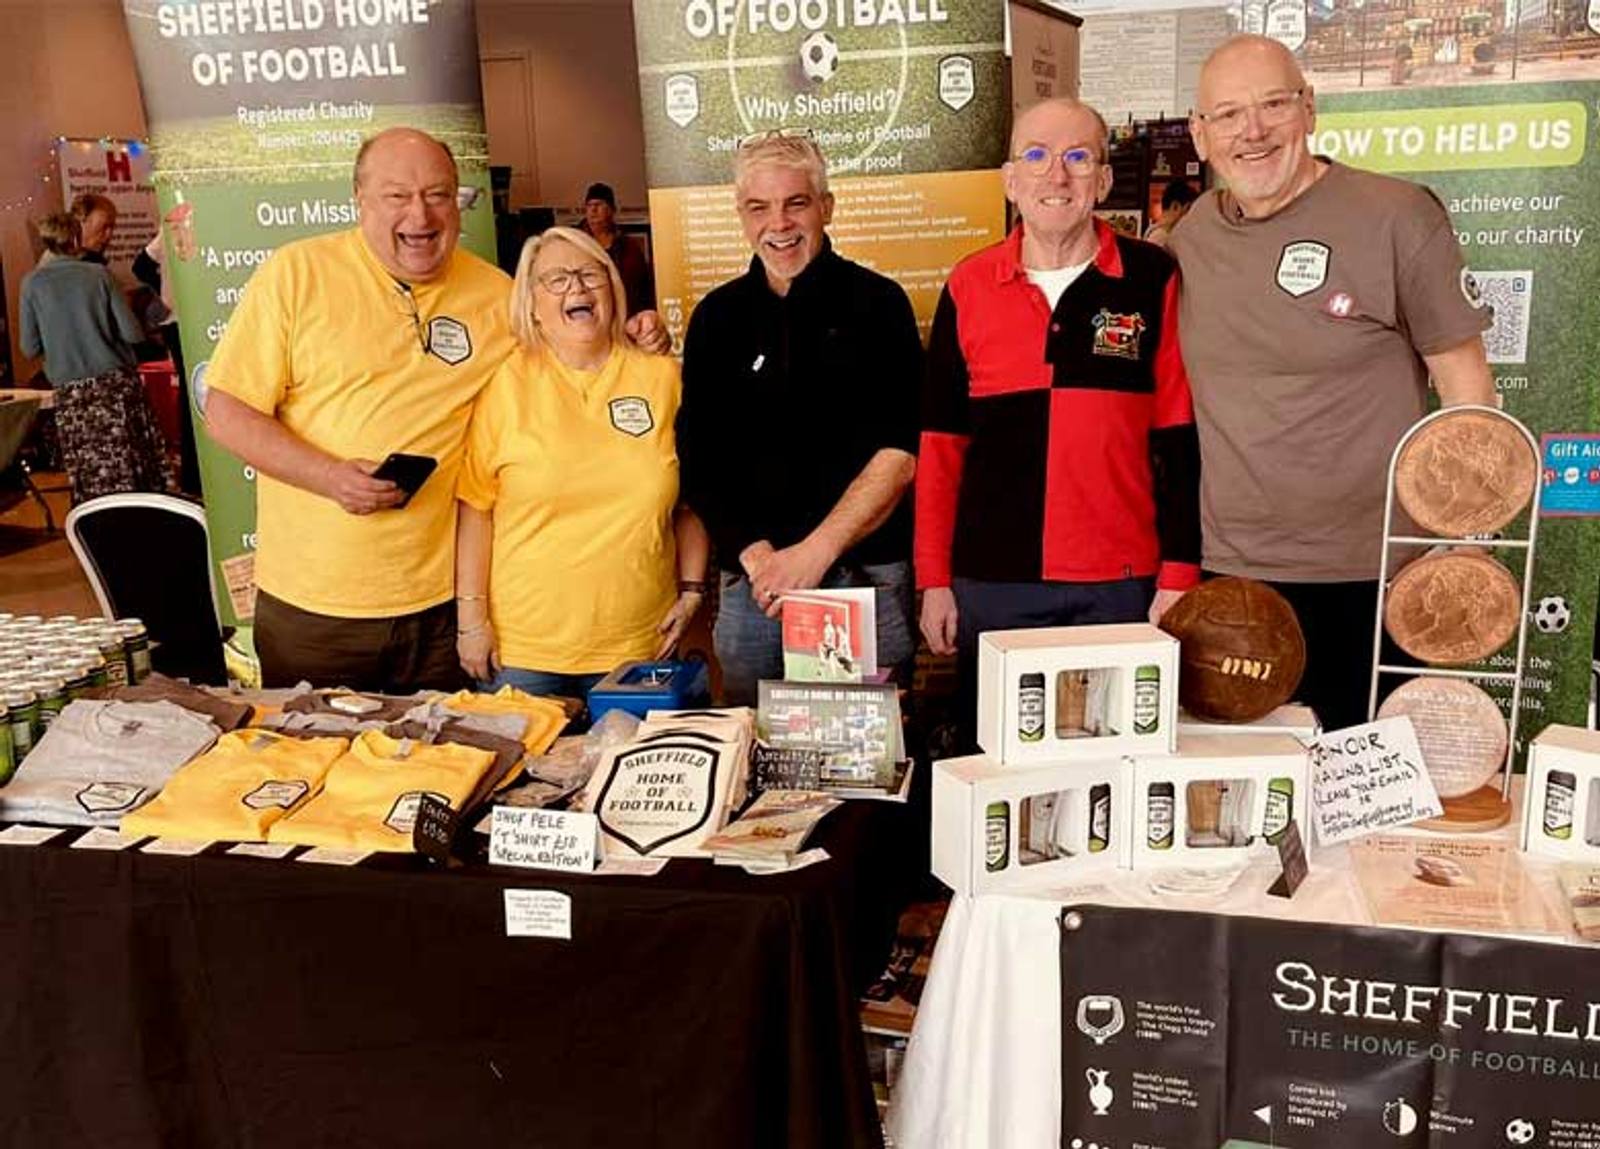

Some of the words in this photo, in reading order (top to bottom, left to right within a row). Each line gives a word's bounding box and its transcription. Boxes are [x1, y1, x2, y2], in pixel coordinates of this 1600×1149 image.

[157, 0, 325, 38] SHEFFIELD
[336, 0, 430, 28] HOME
[685, 0, 736, 38] OF
[750, 0, 949, 34] FOOTBALL
[192, 53, 233, 86] OF
[242, 42, 406, 84] FOOTBALL
[237, 104, 315, 128] Registered
[320, 100, 374, 122] Charity
[746, 96, 789, 125] Why
[795, 88, 901, 118] Sheffield?
[813, 130, 853, 145] Home
[855, 127, 871, 142] of
[1382, 127, 1424, 156] TO
[1435, 122, 1517, 154] HELP
[1528, 119, 1573, 150] US
[838, 154, 861, 169] the
[866, 152, 903, 172] proof
[256, 202, 297, 226] Our
[302, 198, 361, 225] Missi
[1450, 193, 1524, 213] achieve
[1529, 195, 1563, 211] our
[1477, 230, 1509, 246] our
[1515, 224, 1585, 248] charity
[1551, 442, 1578, 457] Gift
[1530, 656, 1553, 670] the
[1345, 732, 1386, 755] OUR
[625, 752, 708, 769] SHEFFIELD
[636, 772, 687, 785] HOME
[646, 786, 670, 798] OF
[609, 799, 697, 813] FOOTBALL
[531, 812, 567, 830] PELE
[1287, 1028, 1332, 1050] THE
[1344, 1034, 1419, 1059] HOME
[1429, 1043, 1462, 1062] OF
[1471, 1050, 1600, 1080] FOOTBALL
[1288, 1104, 1327, 1118] Sheffield
